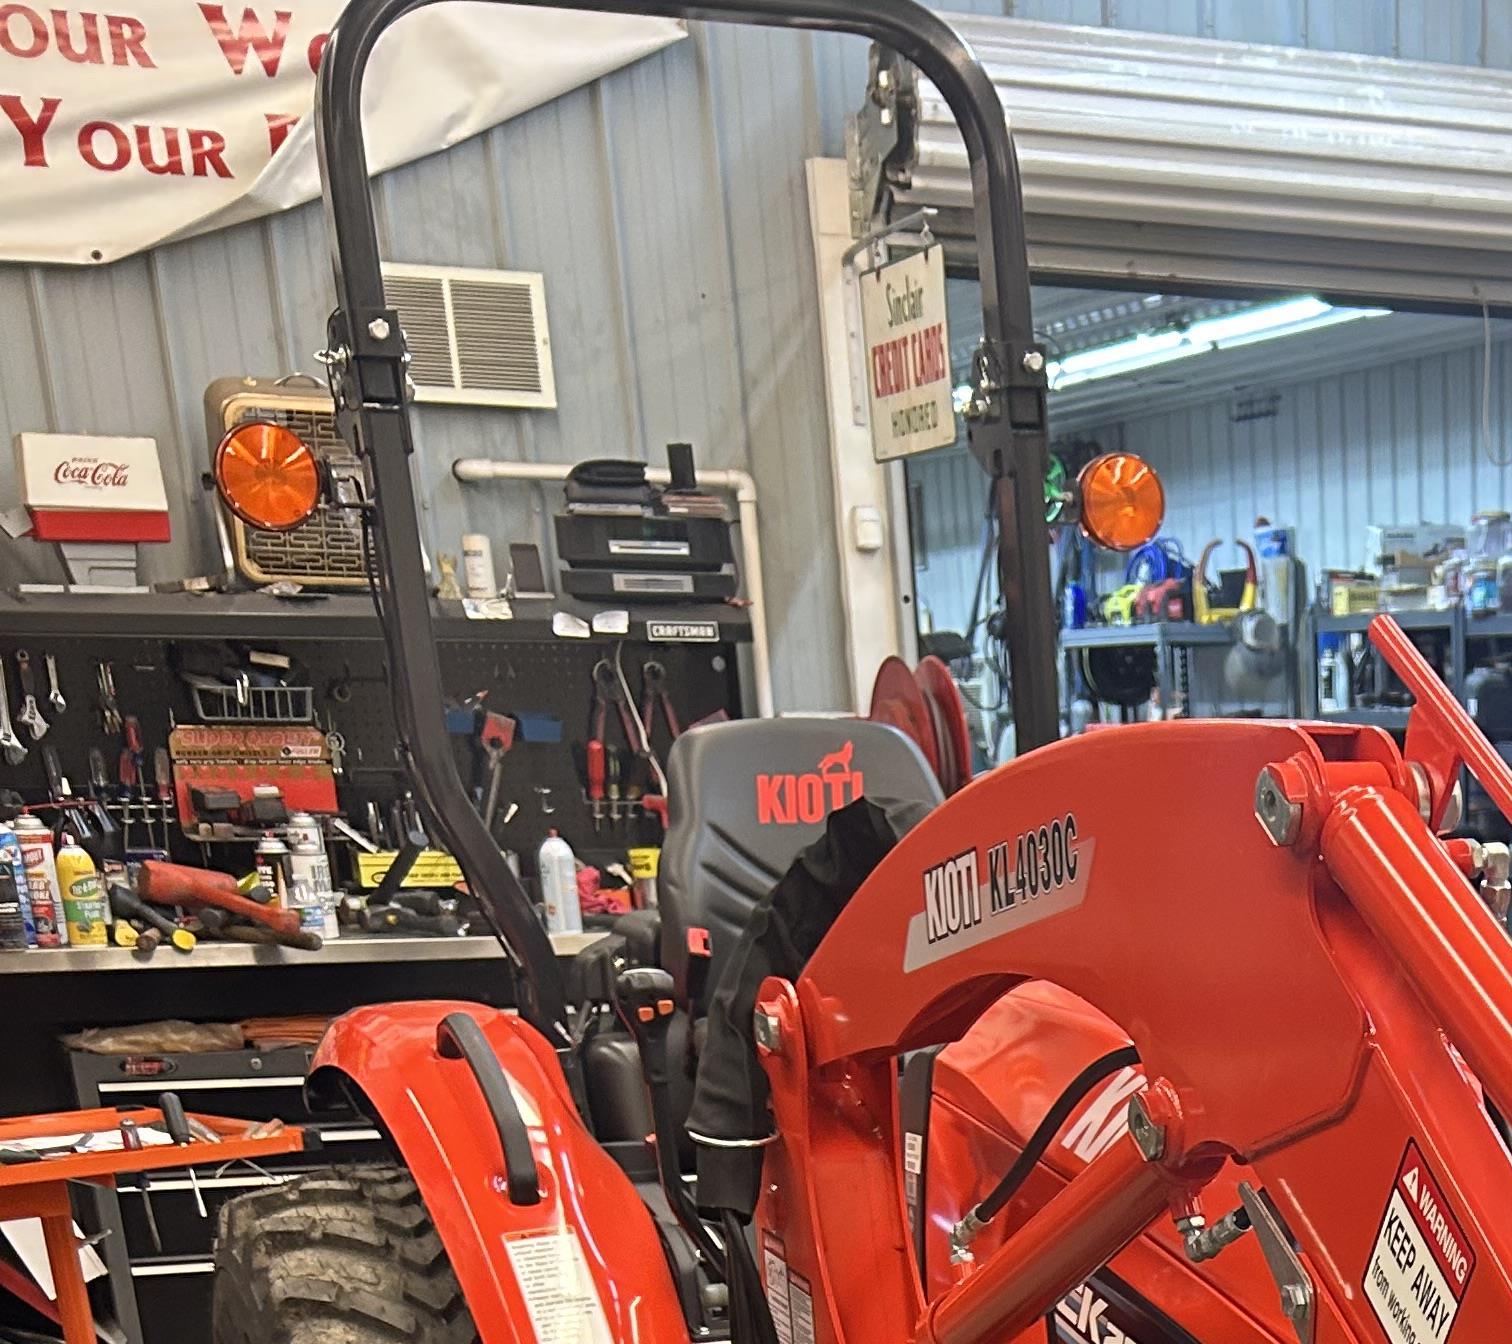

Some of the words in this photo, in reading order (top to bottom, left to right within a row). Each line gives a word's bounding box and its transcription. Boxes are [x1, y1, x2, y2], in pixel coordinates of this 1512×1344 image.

[0, 94, 235, 179] YOUR
[886, 274, 925, 329] Sinclair
[890, 400, 939, 439] HONORED
[54, 460, 130, 487] Coca-Cola
[651, 624, 715, 638] CRAFTSMAN
[924, 846, 982, 944] KIOTI
[987, 812, 1078, 917] KL4030C
[1418, 1183, 1468, 1285] WARNING
[1371, 1255, 1389, 1299] from
[1382, 1207, 1417, 1275] KEEP
[1410, 1265, 1450, 1340] AWAY
